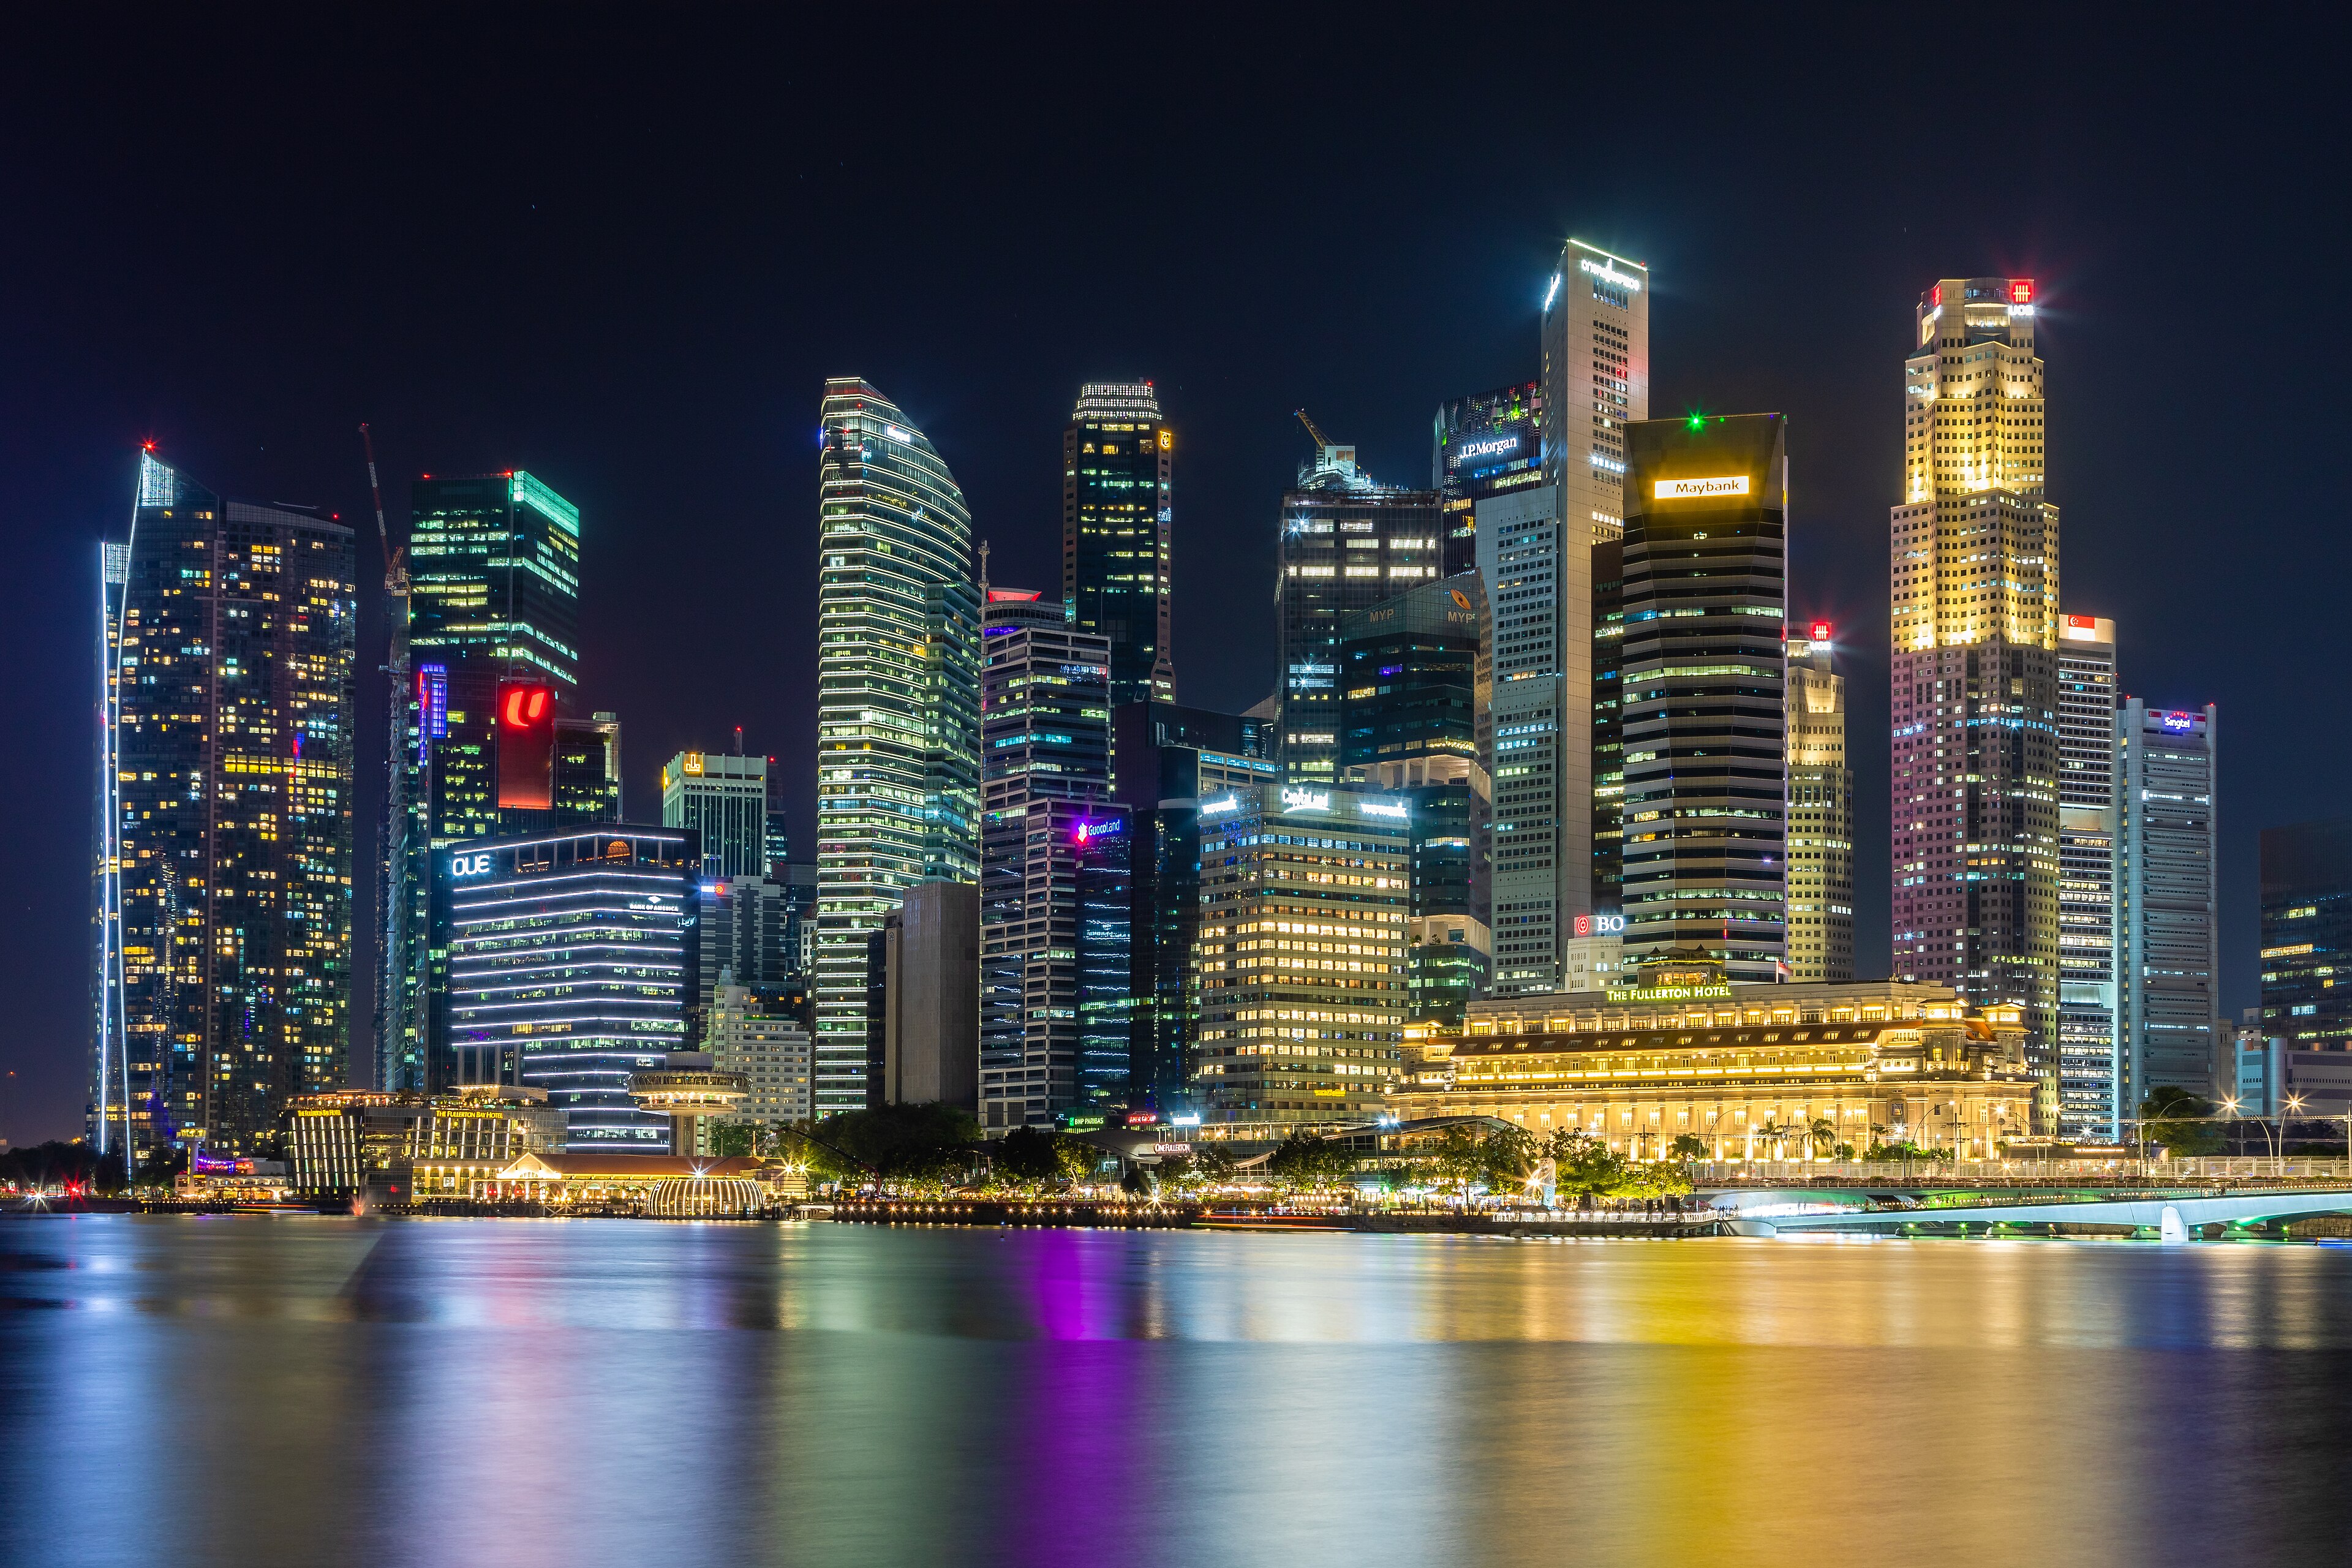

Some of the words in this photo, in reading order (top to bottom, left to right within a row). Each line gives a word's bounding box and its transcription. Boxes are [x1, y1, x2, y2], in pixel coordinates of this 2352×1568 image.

[1460, 437, 1517, 459] J.P.Morgan
[1676, 480, 1740, 495] Maybank
[1370, 608, 1395, 623] MYP
[1447, 611, 1473, 624] MYP
[2165, 717, 2190, 729] Singtel
[453, 854, 490, 876] OUE
[1607, 990, 1627, 1001] THE
[1630, 987, 1691, 1000] FULLERTON
[1695, 986, 1732, 997] HOTEL
